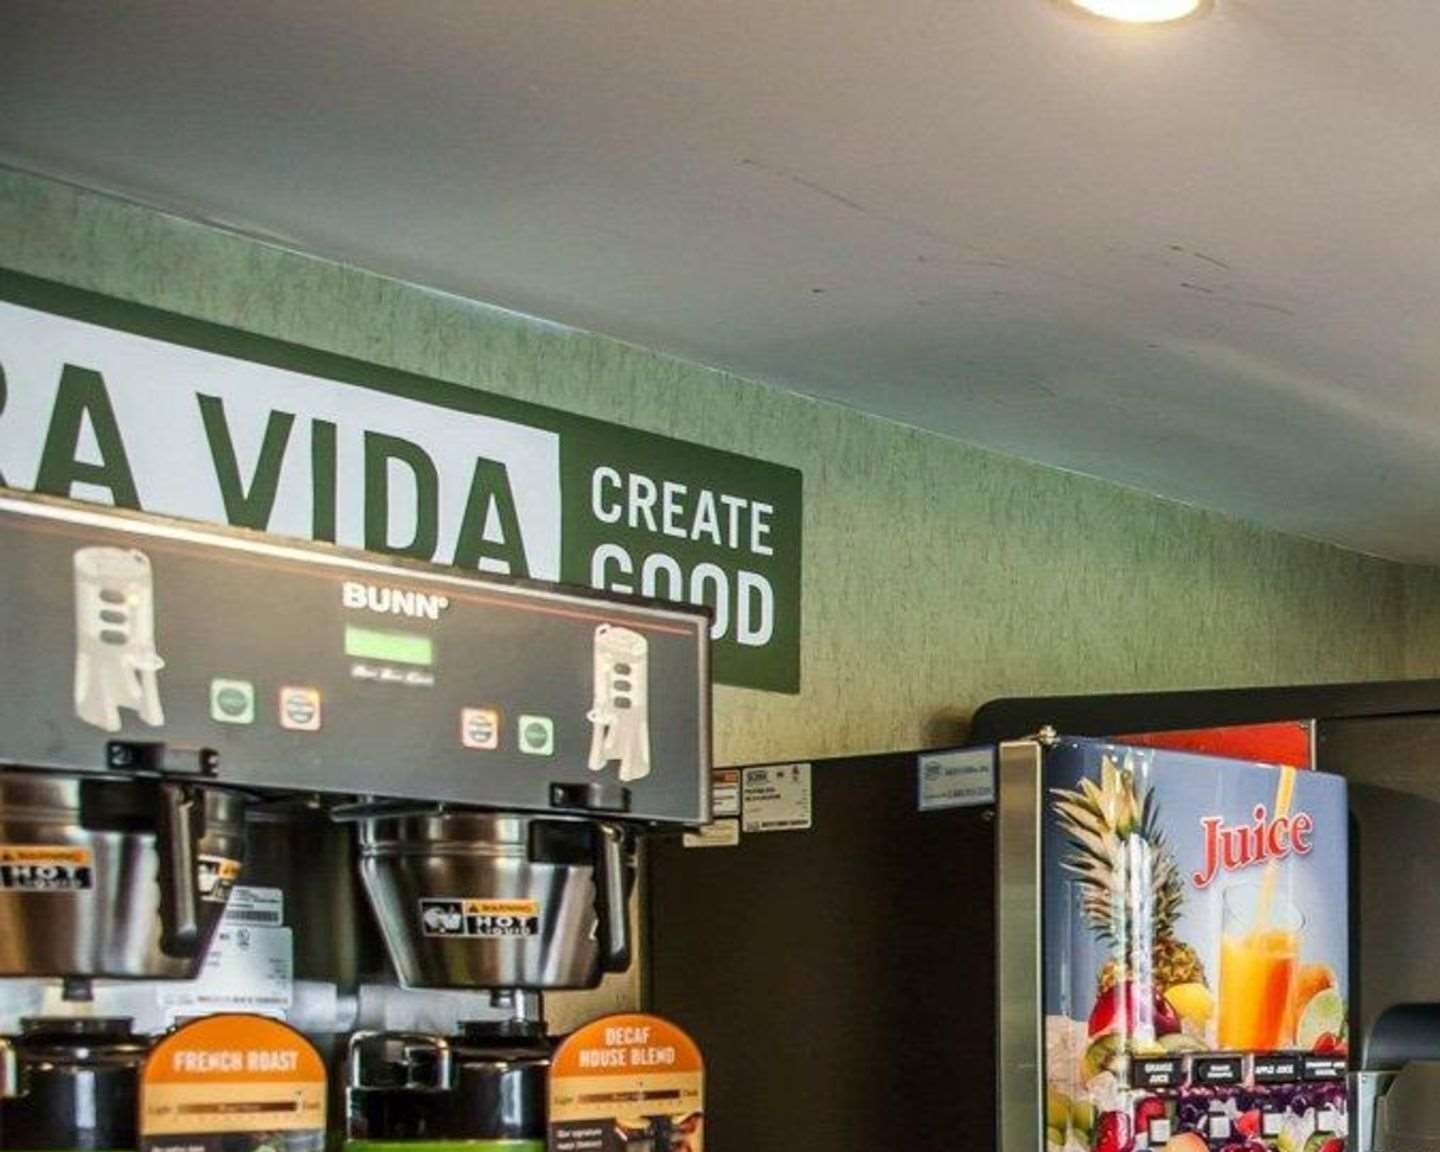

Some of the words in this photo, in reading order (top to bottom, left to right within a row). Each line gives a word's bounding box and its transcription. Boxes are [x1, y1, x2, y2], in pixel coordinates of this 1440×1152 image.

[0, 360, 142, 511] A
[195, 391, 530, 580] VIDA
[592, 466, 774, 556] CREATE
[591, 543, 775, 647] GOOD
[1191, 803, 1313, 888] Juice
[477, 917, 528, 928] HOT
[173, 1051, 242, 1073] FRENCH
[246, 1049, 299, 1073] ROAST
[579, 1048, 628, 1068] HOUSE
[630, 1046, 676, 1066] BLEND
[605, 1027, 650, 1046] DECAF
